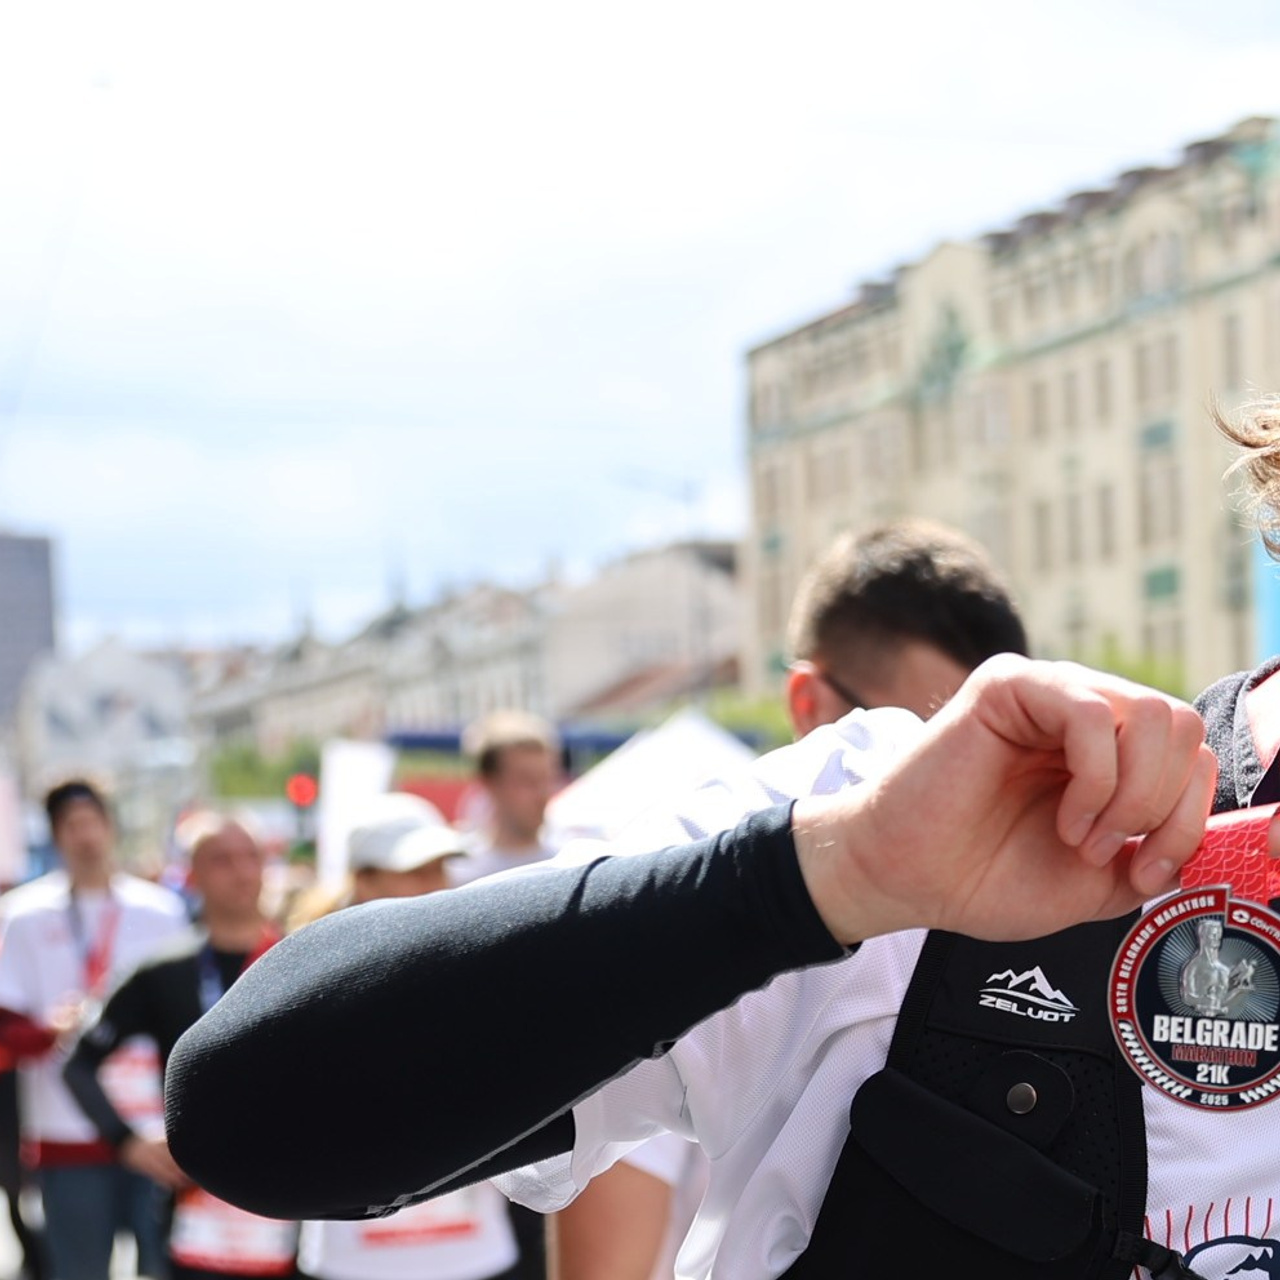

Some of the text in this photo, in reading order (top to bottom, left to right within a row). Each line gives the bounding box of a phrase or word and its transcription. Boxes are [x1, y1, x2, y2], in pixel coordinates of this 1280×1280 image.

[1118, 925, 1157, 980] BELGRADE
[1154, 894, 1216, 928] MARATHON
[1153, 1014, 1280, 1052] BELGRADE
[1171, 1044, 1258, 1069] MARATHON
[1195, 1063, 1231, 1085] 21K
[1199, 1092, 1230, 1107] 2025
